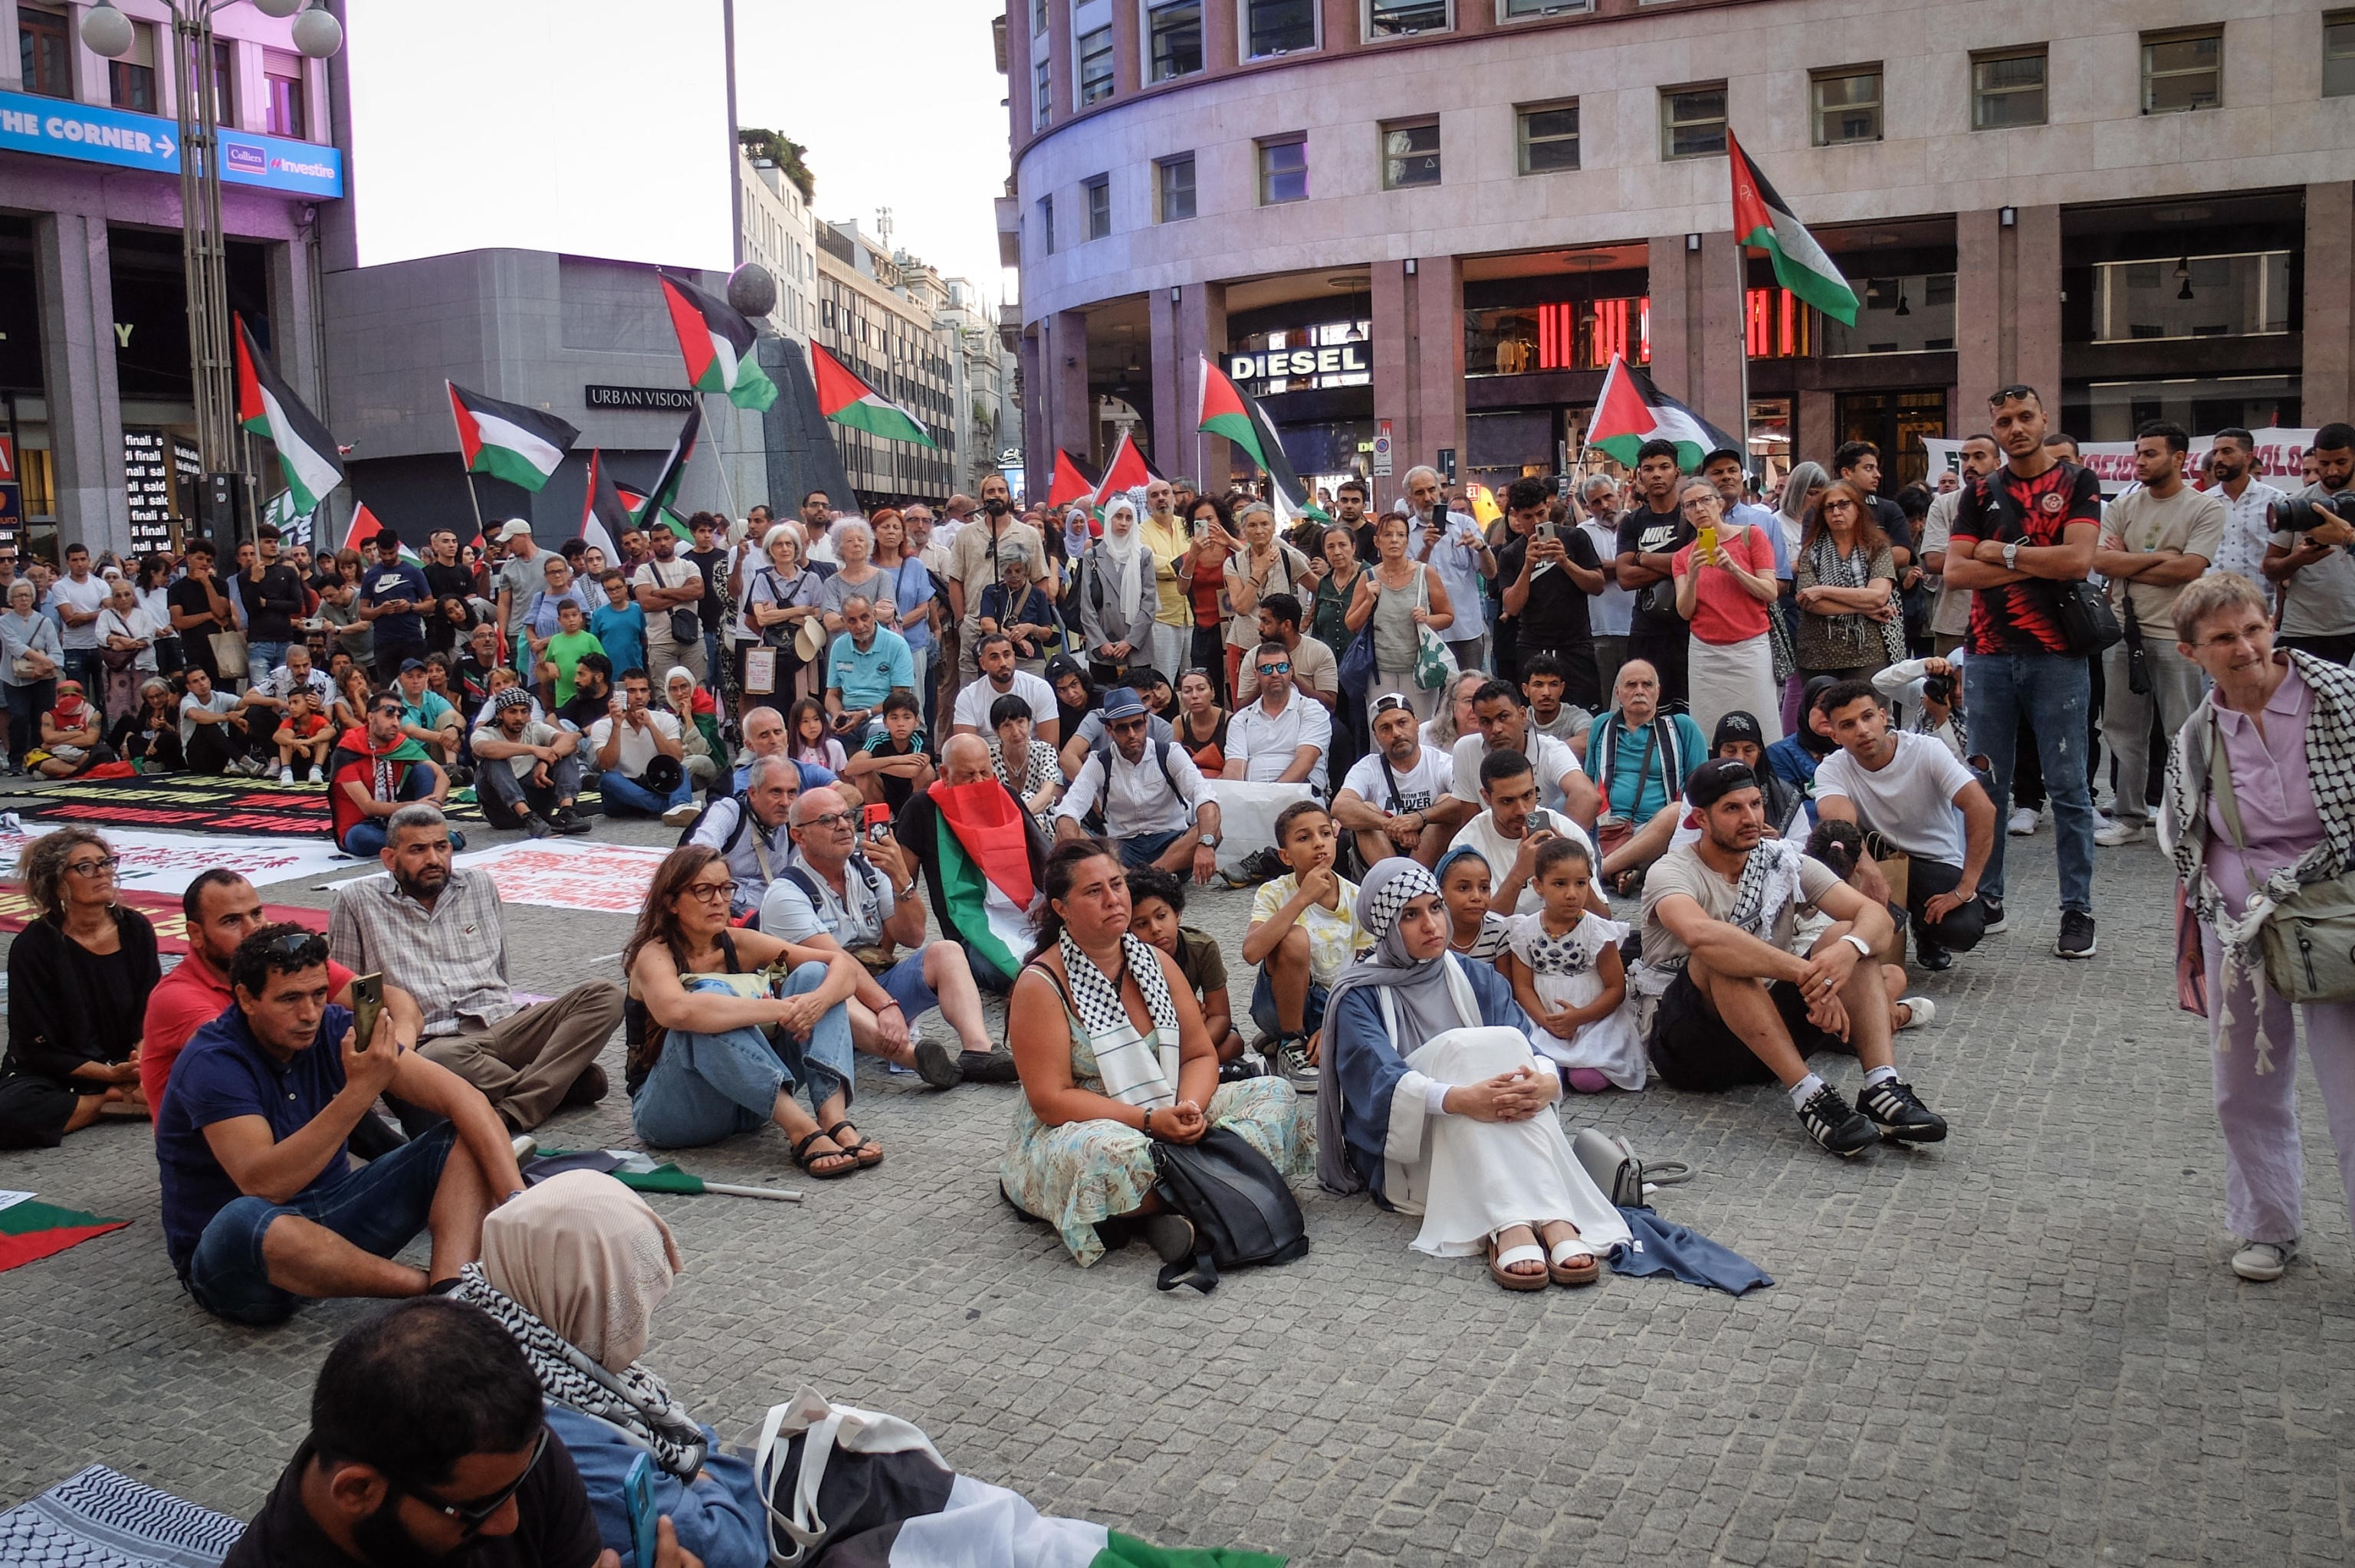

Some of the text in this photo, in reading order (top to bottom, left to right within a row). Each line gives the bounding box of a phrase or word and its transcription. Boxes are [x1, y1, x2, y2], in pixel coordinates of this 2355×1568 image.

[0, 110, 153, 153] HE CORNER
[231, 149, 262, 163] Colliers
[281, 158, 335, 179] Investire
[1231, 348, 1366, 379] DIESEL
[593, 389, 691, 407] URBAN VISION
[125, 435, 152, 446] finali
[135, 450, 161, 461] finali
[131, 510, 158, 521] finali
[141, 525, 167, 536] finali
[1641, 525, 1675, 543] NIKE
[379, 574, 402, 585] NIKE
